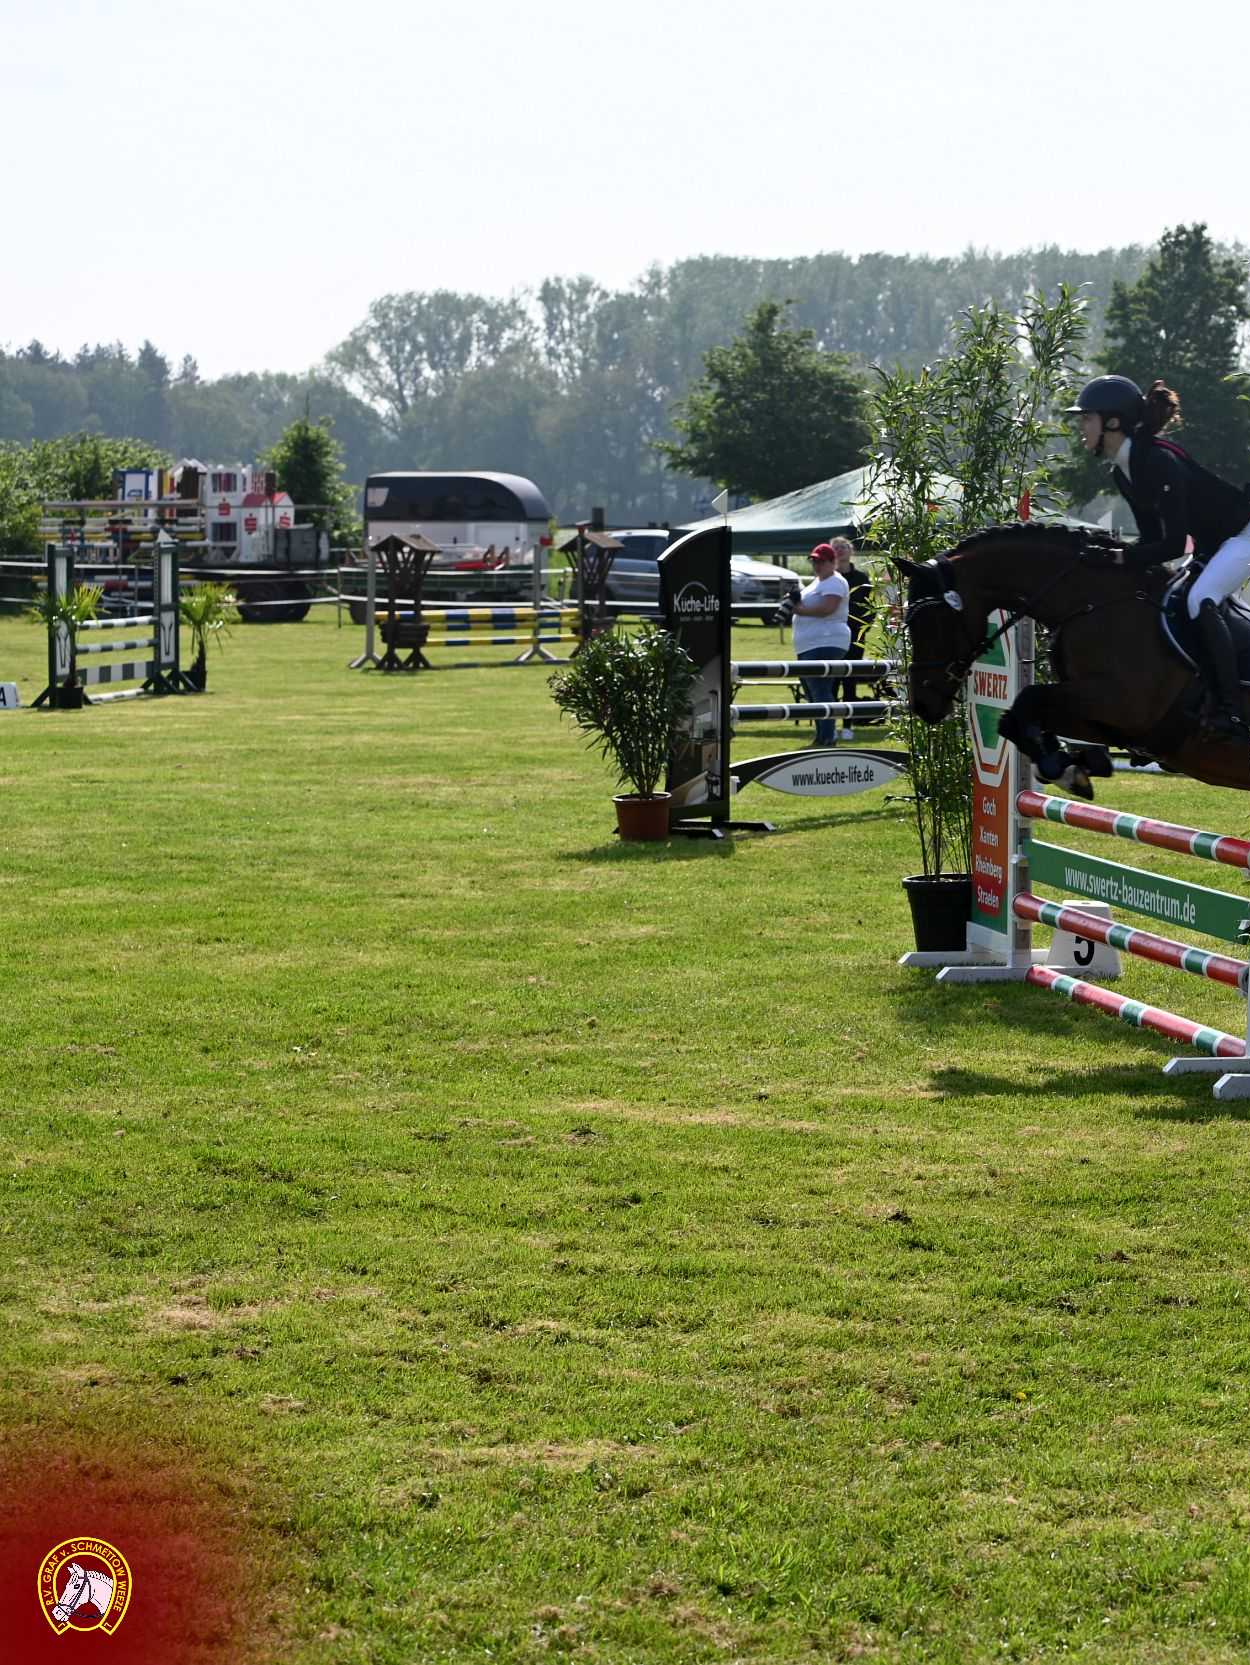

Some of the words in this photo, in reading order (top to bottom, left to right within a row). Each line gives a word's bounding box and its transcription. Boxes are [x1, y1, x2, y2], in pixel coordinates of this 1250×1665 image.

[973, 671, 1008, 700] SWERTZ
[792, 764, 875, 787] www.kueche-life.de
[982, 796, 997, 817] Goch
[979, 825, 999, 848] Xanten
[975, 853, 1003, 884] Rheinberg
[977, 885, 1000, 909] Straelen
[1064, 866, 1197, 925] www.swertz-bauzentrum.de
[1073, 936, 1095, 966] 5
